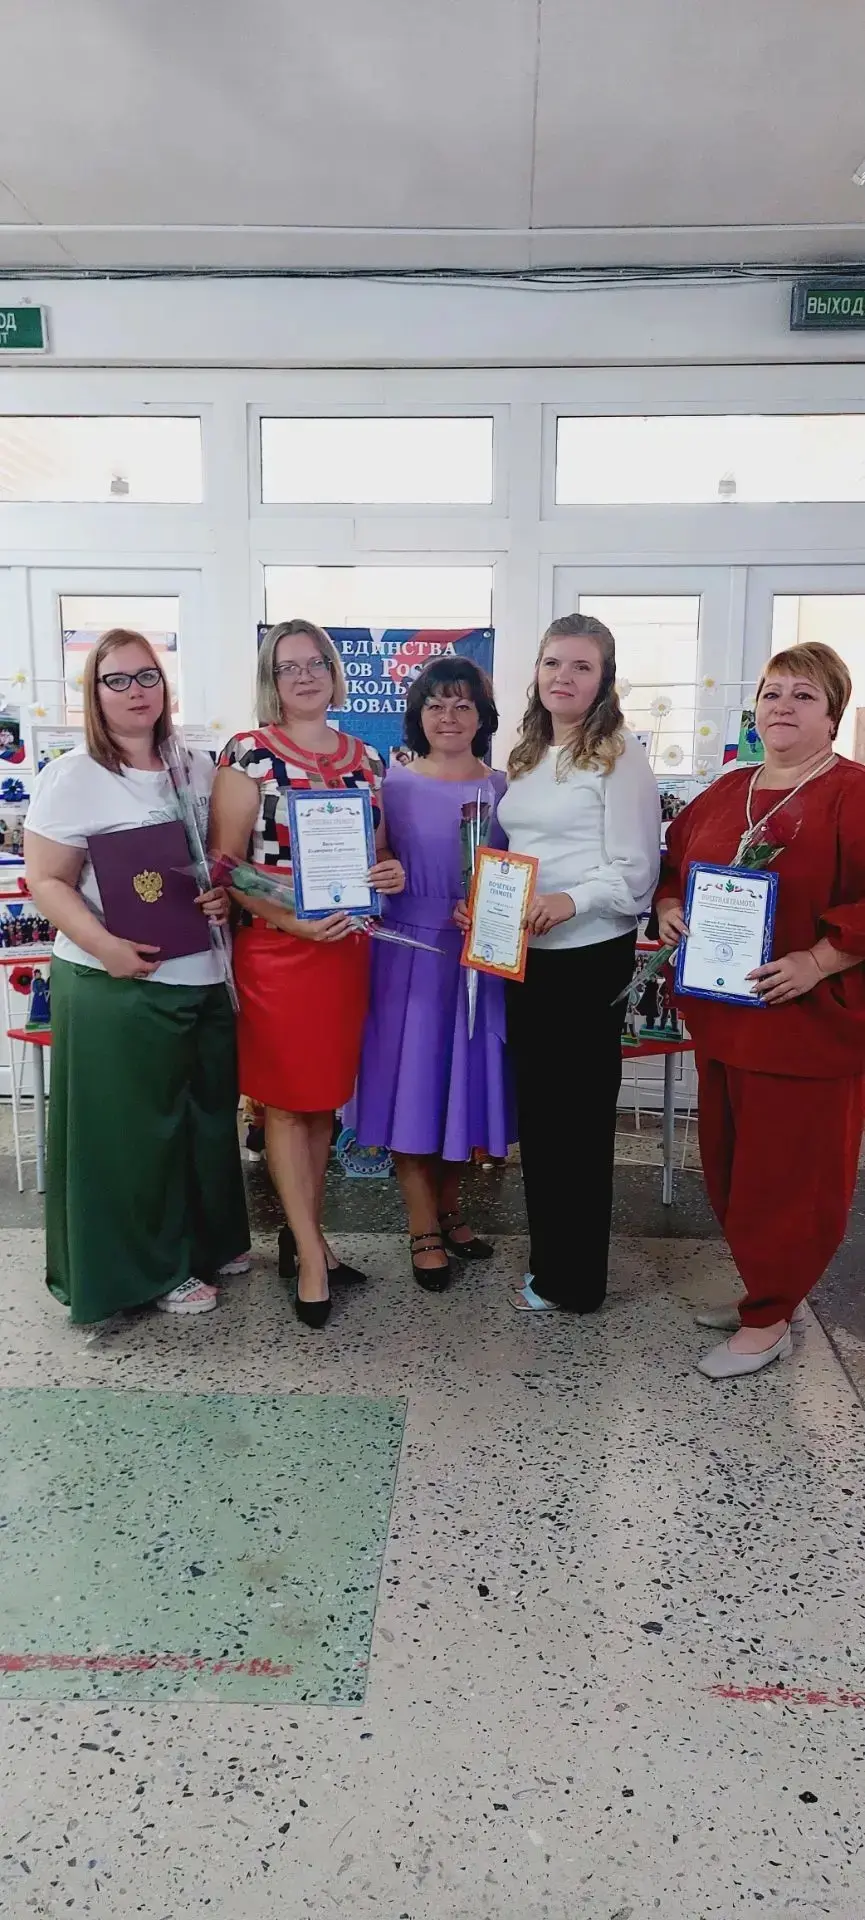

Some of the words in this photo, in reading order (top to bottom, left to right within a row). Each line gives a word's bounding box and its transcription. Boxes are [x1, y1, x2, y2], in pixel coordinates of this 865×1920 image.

[807, 296, 864, 316] ВЫХОД
[341, 639, 457, 656] ЕДИНСТВА
[346, 680, 409, 696] КОЛЬ
